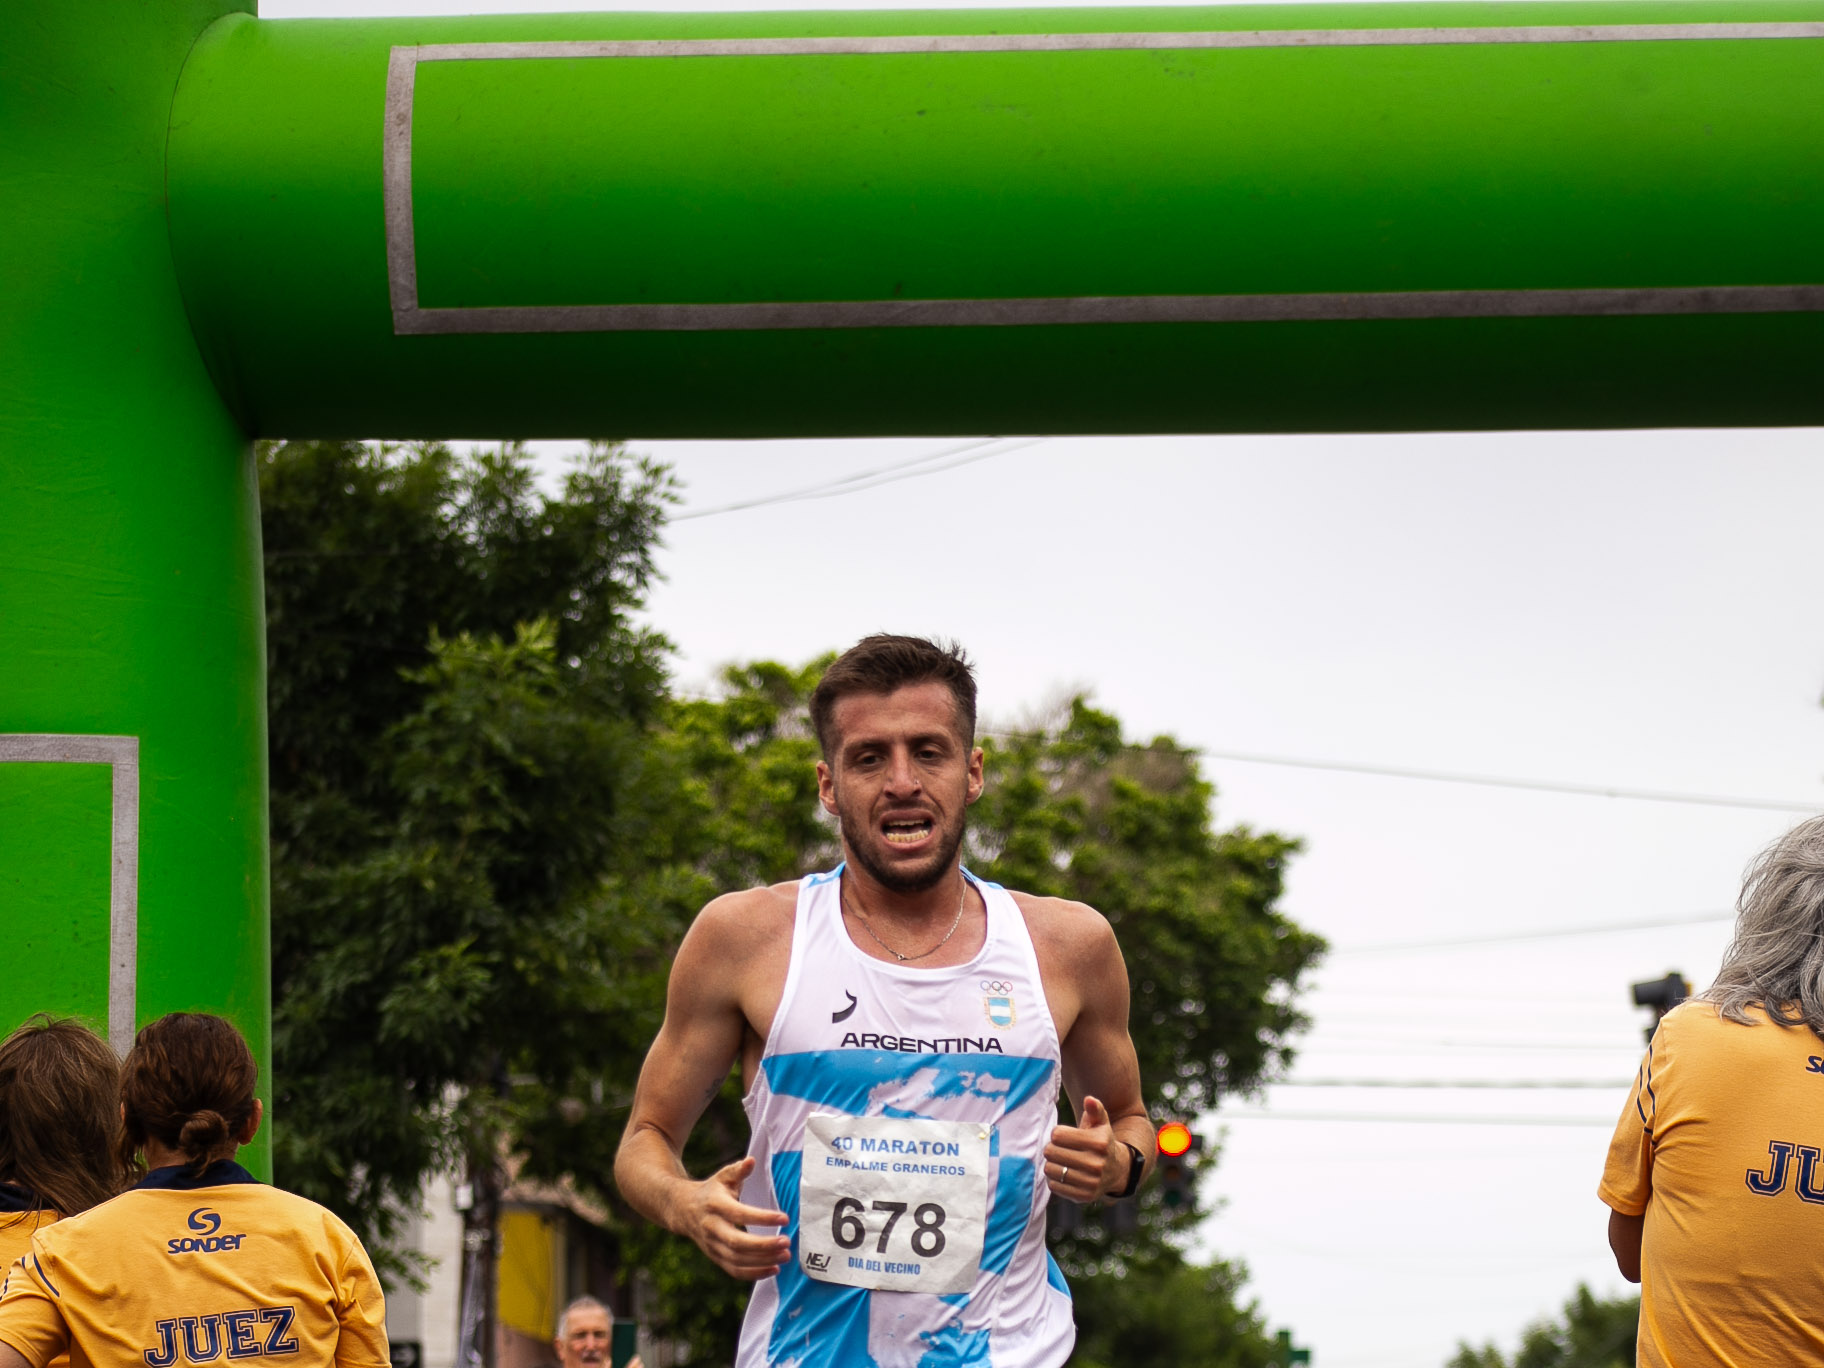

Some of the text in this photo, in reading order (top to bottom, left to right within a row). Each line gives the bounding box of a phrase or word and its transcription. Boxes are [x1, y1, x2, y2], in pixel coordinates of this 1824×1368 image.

[840, 1032, 1004, 1054] ARGENTINA
[831, 1136, 960, 1157] 40 MARATON
[825, 1156, 966, 1177] EMPALME GRANEROS
[831, 1196, 947, 1258] 678
[847, 1256, 921, 1276] DIA DEL VECINO
[143, 1305, 300, 1368] JUEZ
